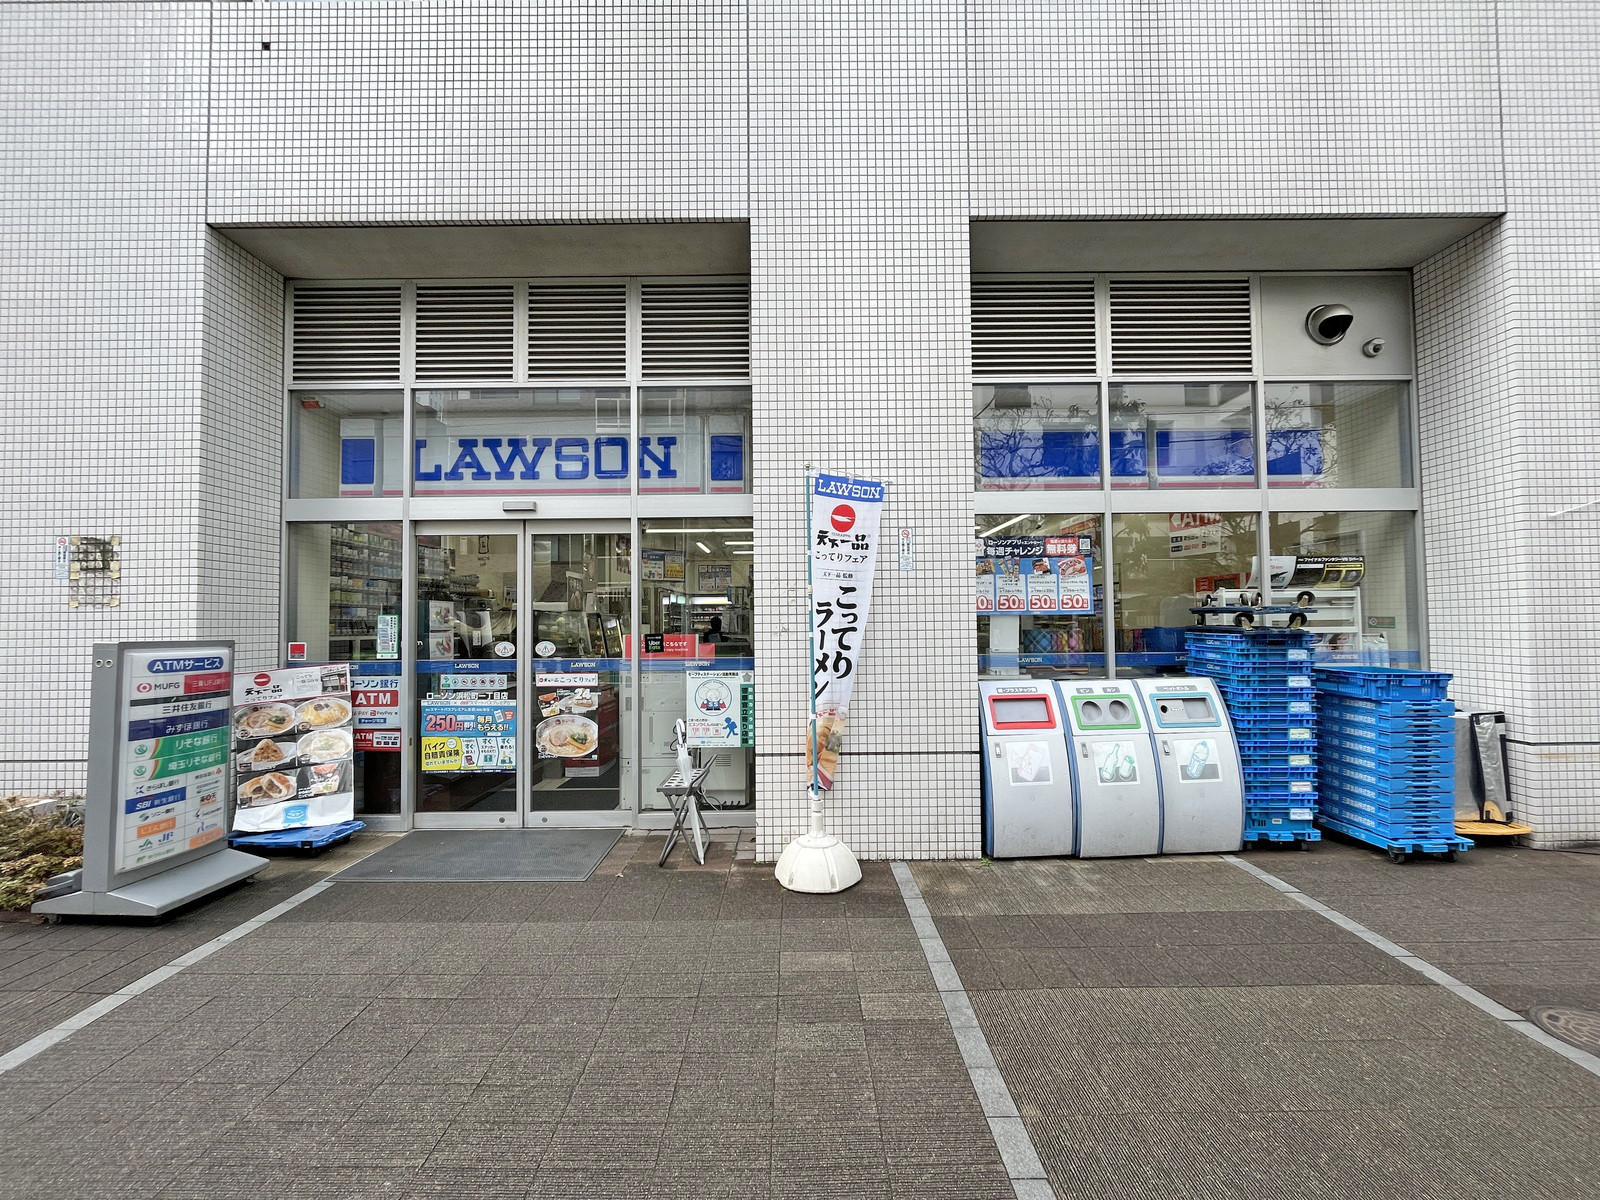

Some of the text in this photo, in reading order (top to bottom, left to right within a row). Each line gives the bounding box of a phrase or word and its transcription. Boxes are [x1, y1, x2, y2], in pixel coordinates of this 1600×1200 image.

[415, 437, 677, 481] LAWSON
[817, 479, 882, 499] LAWSON
[986, 546, 1044, 556] 毎週チャレンジ
[1046, 543, 1077, 554] 無料券
[815, 551, 868, 563] こってりフェア
[999, 594, 1019, 609] 50
[1031, 594, 1050, 609] 50
[1062, 594, 1082, 608] 50
[831, 585, 859, 680] こってり
[814, 601, 834, 700] ラーメン
[152, 658, 220, 671] ATMサービス
[154, 682, 180, 690] MUFG
[355, 692, 391, 705] ATM
[426, 692, 509, 700] ローソン浜松町一丁目店
[162, 701, 212, 714] 三井住友銀行
[166, 720, 208, 734] みずほ銀行
[175, 734, 217, 750] りそな銀行
[424, 742, 446, 751] バイク
[168, 752, 221, 771] 埼玉りそな銀行
[136, 800, 151, 810] SBI
